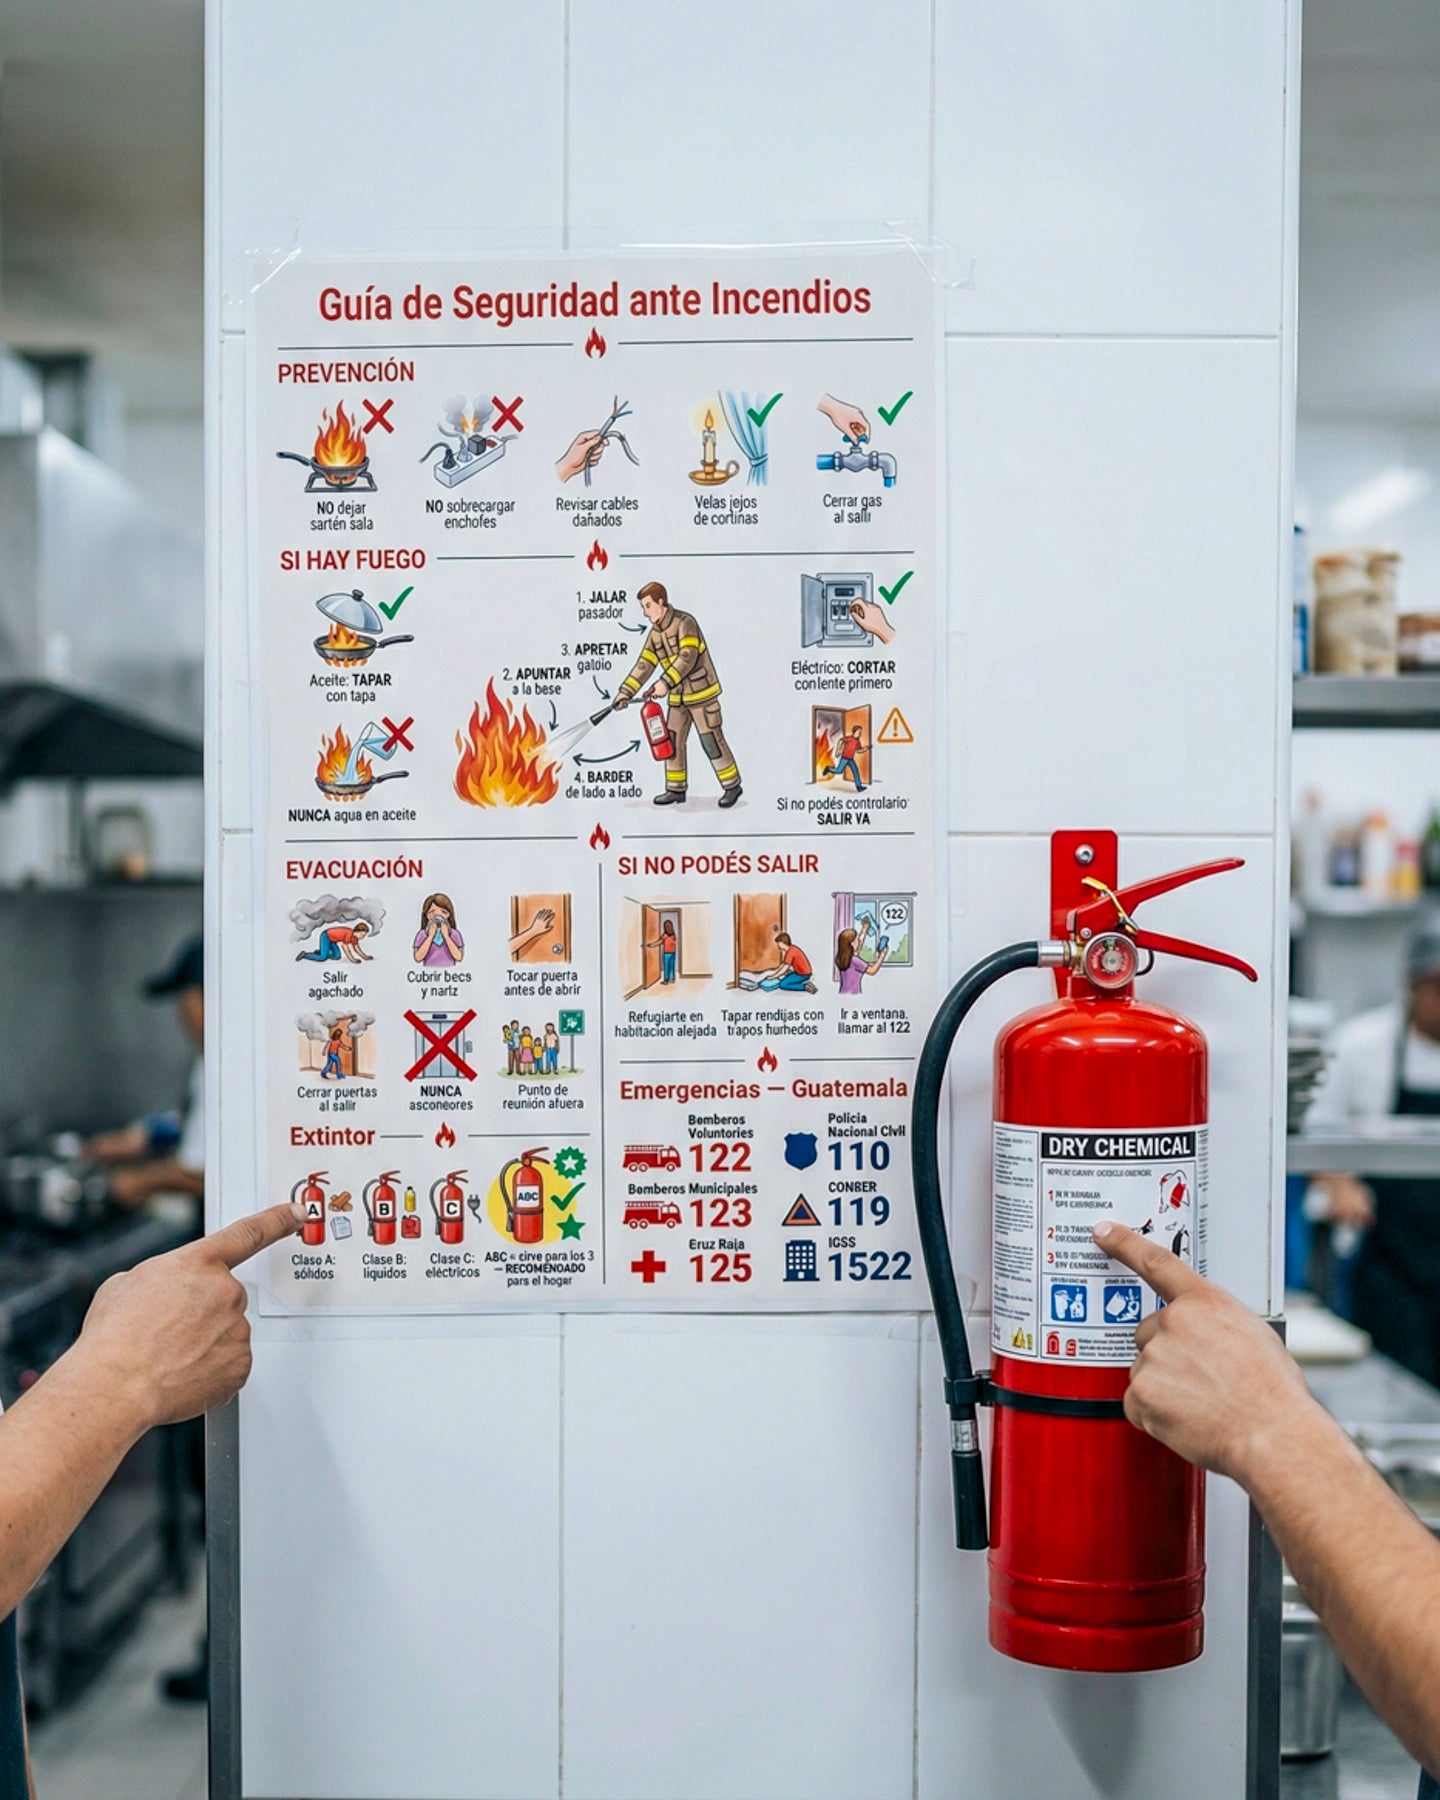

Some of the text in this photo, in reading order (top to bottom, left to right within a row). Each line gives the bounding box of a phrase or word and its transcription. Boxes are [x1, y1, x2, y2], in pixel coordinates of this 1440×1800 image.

[319, 278, 871, 327] Guía de Seguridad ante Incendios
[278, 356, 414, 383] PREVENCIÓN
[317, 500, 366, 517] NO dejar
[426, 498, 515, 516] NO sobrecargar
[556, 496, 639, 511] Revisar cables
[694, 495, 727, 509] Velas
[823, 493, 882, 510] Cerrar gas
[310, 515, 346, 531] sartén
[444, 514, 497, 529] enchofes
[572, 512, 623, 527] dañados
[693, 511, 709, 526] de
[833, 509, 844, 524] al
[280, 549, 426, 571] SI HAY FUEGO
[576, 590, 627, 604] 1. JALAR
[578, 605, 624, 622] pasador
[561, 642, 628, 656] 3. APRETAR
[516, 667, 571, 680] APUNTAR
[791, 660, 896, 675] Eléctrico: CORTAR
[351, 673, 392, 686] TAPAR
[848, 676, 893, 692] primero
[512, 685, 519, 695] a
[522, 682, 532, 695] la
[326, 690, 376, 705] con tapa
[565, 784, 643, 799] de lado a lado
[777, 797, 788, 811] Si
[791, 799, 805, 811] no
[808, 797, 843, 812] podés
[288, 808, 416, 824] NUNCA agua en aceite
[817, 812, 852, 825] SALIR
[286, 855, 423, 879] EVACUACIÓN
[618, 850, 819, 876] SI NO PODÉS SALIR
[886, 908, 904, 919] 122
[323, 971, 348, 984] Salir
[407, 970, 442, 983] Cubrir
[507, 969, 539, 982] Tocar
[308, 984, 364, 1001] agachado
[421, 987, 428, 1000] y
[504, 983, 581, 996] antes de abrir
[689, 1012, 703, 1023] en
[721, 1009, 753, 1026] Tapar
[803, 1011, 824, 1021] con
[841, 1008, 849, 1020] Ir
[851, 1010, 859, 1020] a
[676, 1024, 717, 1040] alejada
[876, 1021, 887, 1034] al
[890, 1021, 911, 1033] 122
[297, 1086, 378, 1100] Cerrar puertas
[420, 1085, 462, 1097] NUNCA
[518, 1083, 569, 1096] Punto de
[620, 1079, 761, 1104] Emergencias
[792, 1077, 908, 1098] Guatemala
[319, 1099, 329, 1112] al
[502, 1097, 584, 1110] reunión afuera
[688, 1113, 746, 1126] Bomberos
[290, 1126, 376, 1146] Extintor
[828, 1125, 877, 1138] Nacional
[1049, 1137, 1089, 1157] DRY
[1094, 1136, 1191, 1157] CHEMICAL
[689, 1142, 752, 1172] 122
[828, 1140, 890, 1171] 110
[628, 1182, 758, 1197] Bomberos Municipales
[1048, 1190, 1054, 1201] 1
[517, 1192, 539, 1202] ABC
[308, 1203, 319, 1216] A
[379, 1203, 390, 1216] B
[446, 1202, 458, 1215] C
[690, 1198, 752, 1228] 123
[828, 1195, 890, 1226] 119
[1047, 1227, 1054, 1239] 2
[324, 1254, 336, 1265] A:
[362, 1253, 407, 1265] Clase B:
[430, 1252, 475, 1265] Clase C:
[484, 1251, 508, 1263] ABC
[545, 1252, 568, 1264] para
[570, 1250, 585, 1261] los
[587, 1250, 595, 1261] 3
[1047, 1253, 1054, 1264] 3
[690, 1253, 752, 1283] 125
[828, 1251, 912, 1281] 1522
[531, 1275, 541, 1286] el
